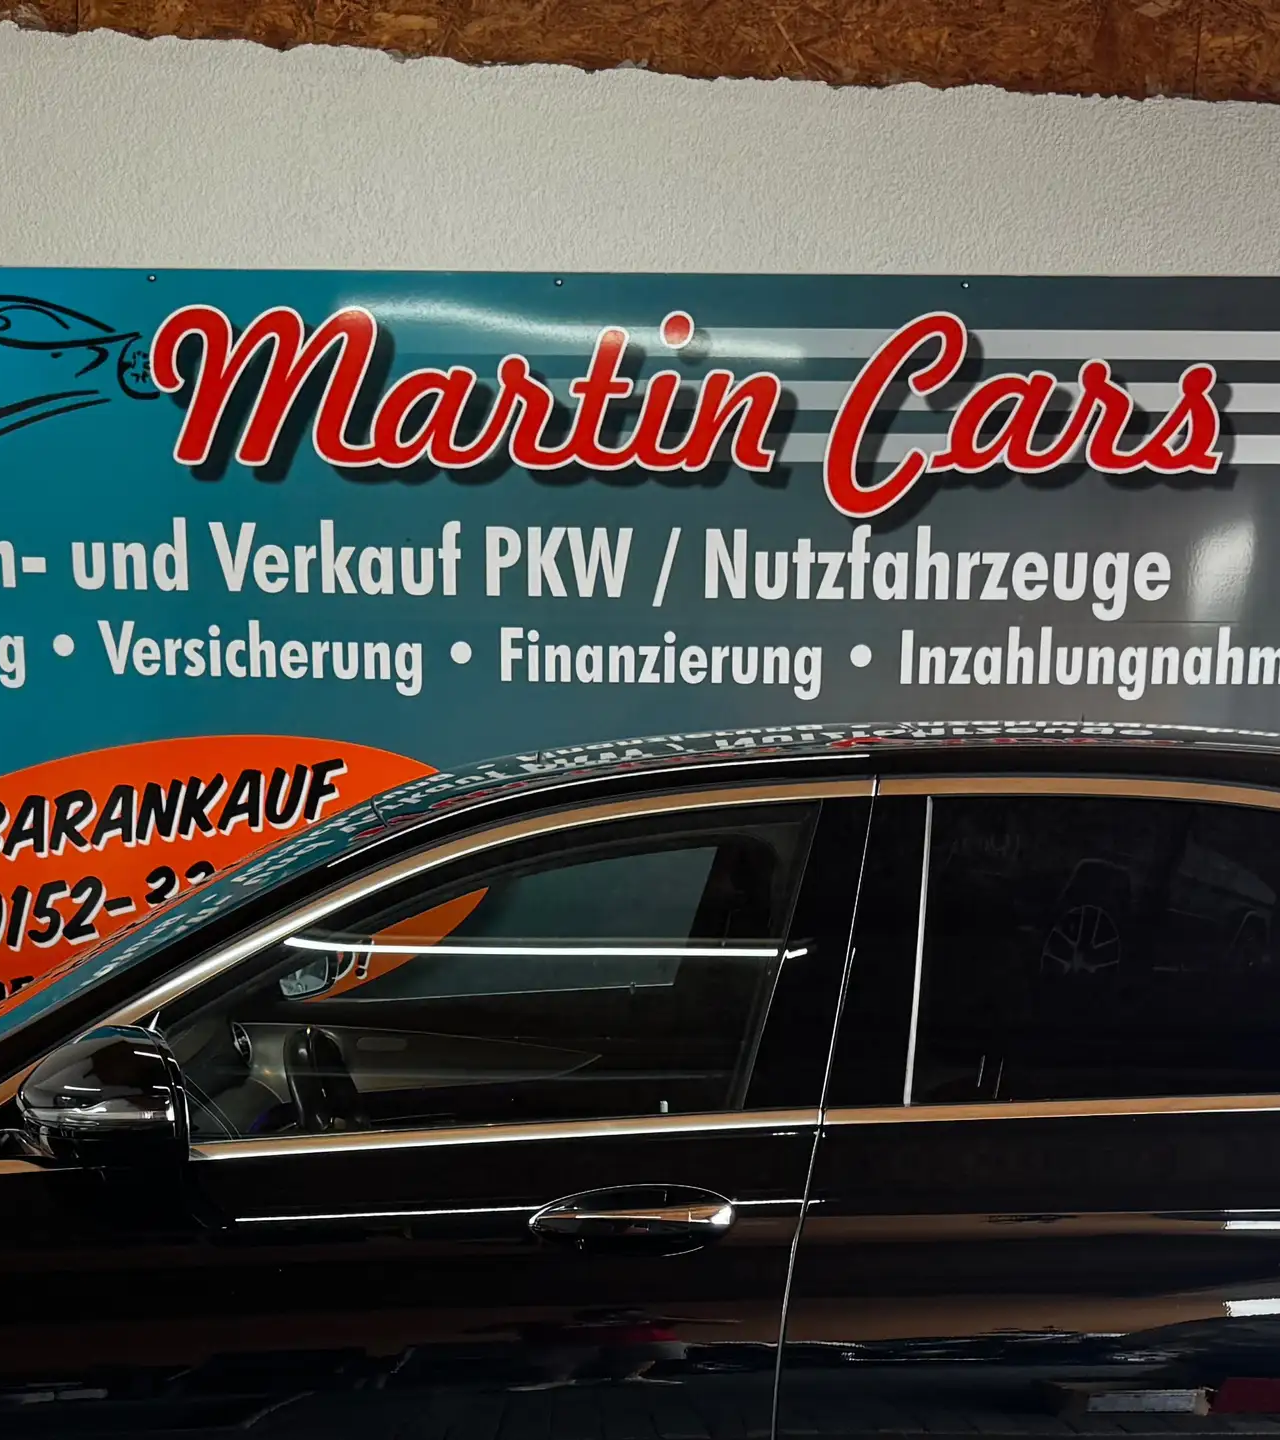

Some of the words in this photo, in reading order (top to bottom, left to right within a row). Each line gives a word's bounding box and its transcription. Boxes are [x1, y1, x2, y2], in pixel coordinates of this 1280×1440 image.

[150, 304, 778, 472] Martin
[823, 311, 1220, 518] Cars
[72, 517, 189, 592] und
[208, 519, 462, 597] Verkauf
[485, 526, 634, 598] PKW
[704, 525, 1172, 622] Nutzfahrzeuge
[97, 619, 423, 697] Versicherung
[500, 626, 823, 701] Finanzierung
